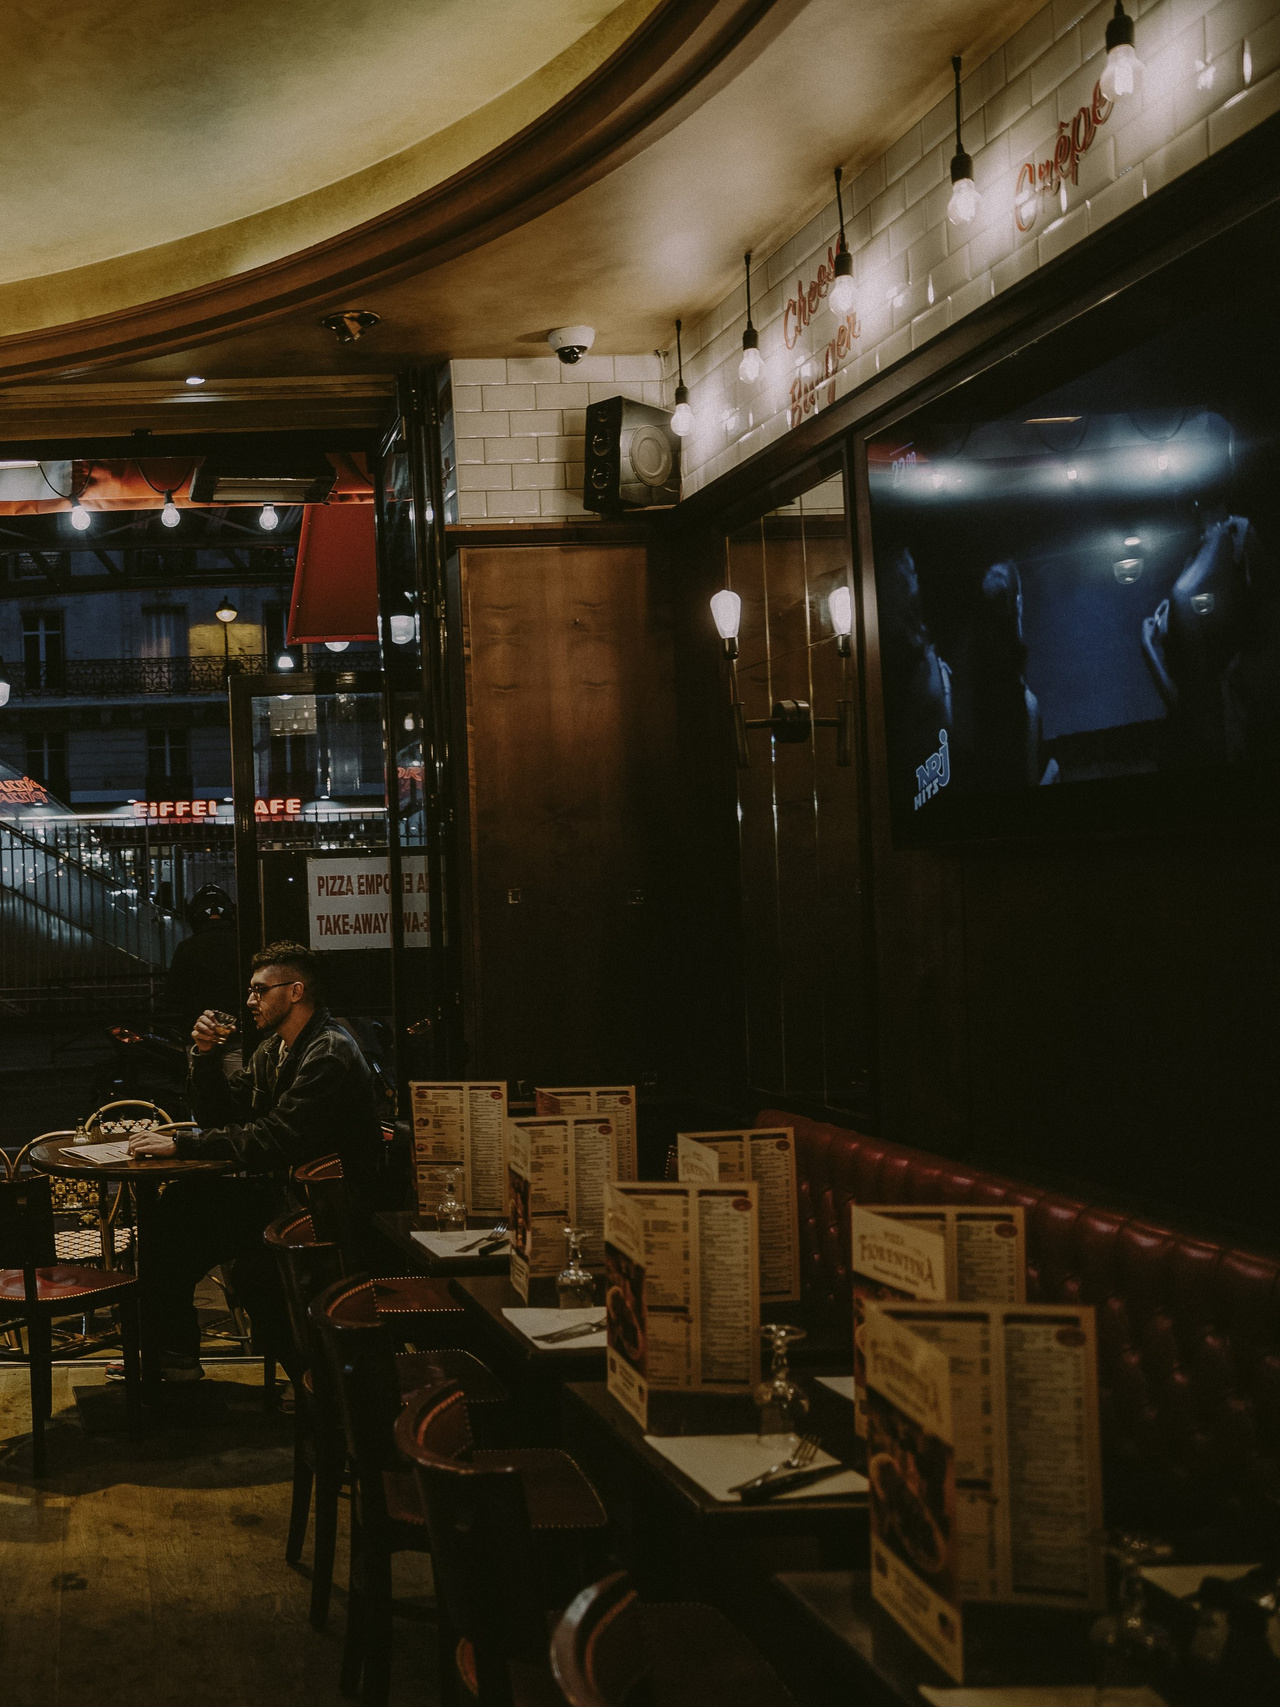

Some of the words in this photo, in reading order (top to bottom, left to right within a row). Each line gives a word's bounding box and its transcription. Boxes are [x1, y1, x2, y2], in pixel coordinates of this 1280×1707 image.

[914, 777, 940, 811] HITS
[254, 798, 301, 816] AFE
[317, 874, 355, 897] PIZZA
[316, 912, 389, 936] TAKE-AWAY
